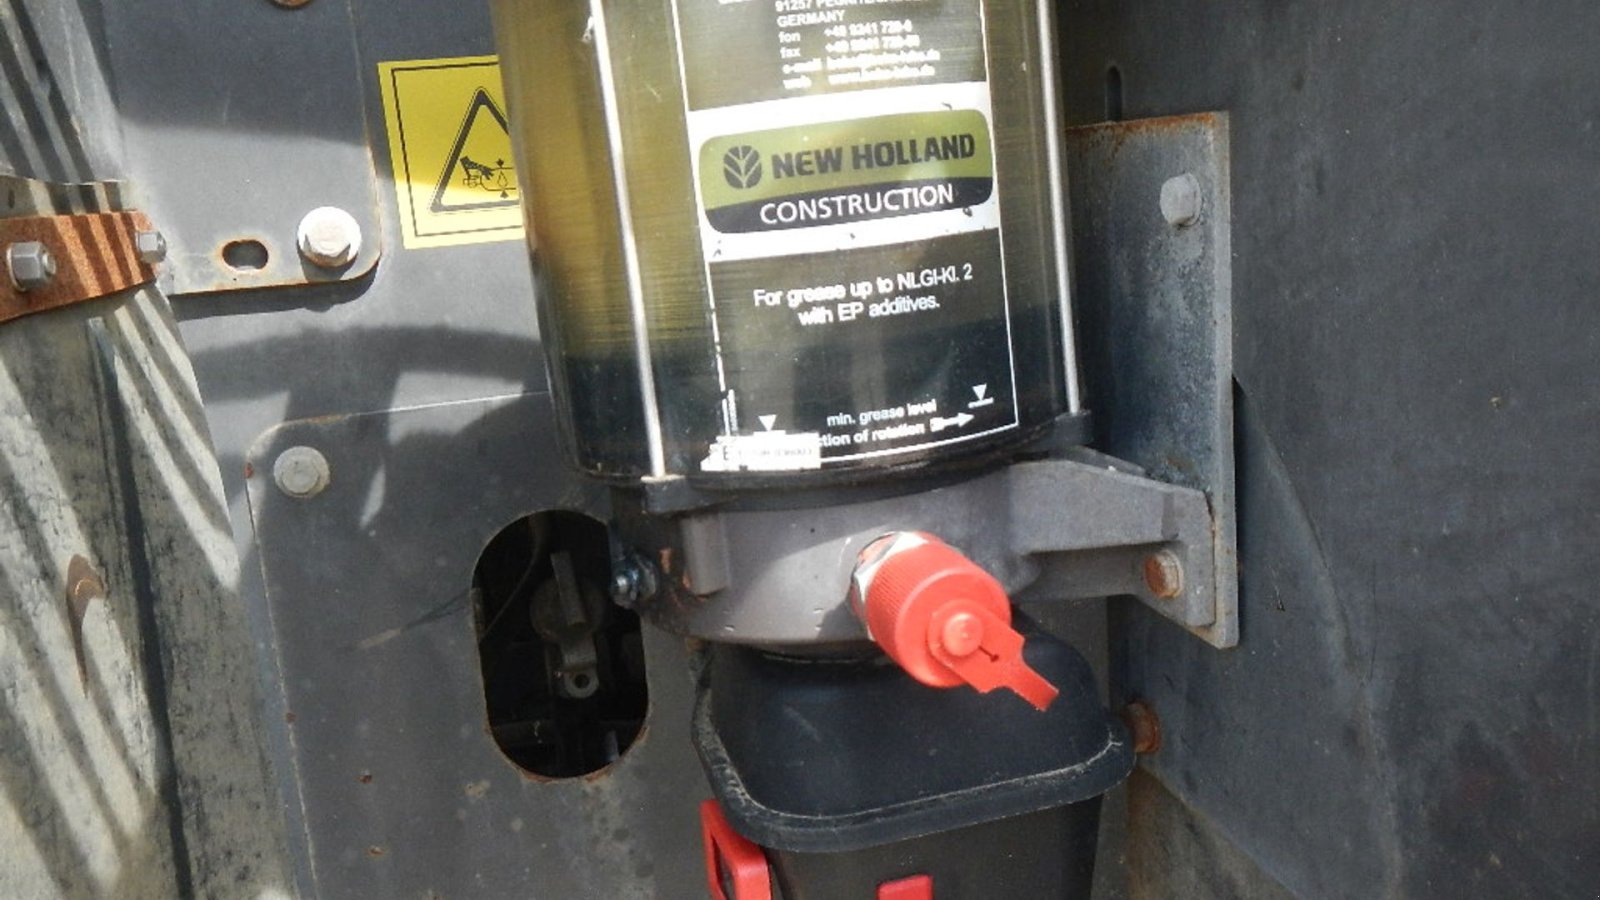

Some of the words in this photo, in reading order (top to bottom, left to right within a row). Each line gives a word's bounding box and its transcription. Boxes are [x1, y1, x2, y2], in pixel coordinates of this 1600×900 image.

[776, 9, 846, 28] GERMANY
[778, 30, 801, 44] fon
[779, 47, 801, 59] fax
[771, 146, 843, 179] NEW
[852, 133, 976, 170] HOLLAND
[759, 183, 954, 225] CONSTRUCTION
[753, 288, 783, 307] For
[787, 284, 846, 308] grease
[850, 281, 873, 300] up
[876, 277, 893, 294] to
[962, 263, 973, 281] 2
[798, 307, 834, 326] with
[837, 301, 865, 322] EP
[869, 294, 941, 318] additives.
[826, 411, 856, 427] min.
[859, 406, 905, 425] grease
[907, 399, 937, 417] level
[853, 430, 868, 444] of
[872, 422, 925, 441] rotation
